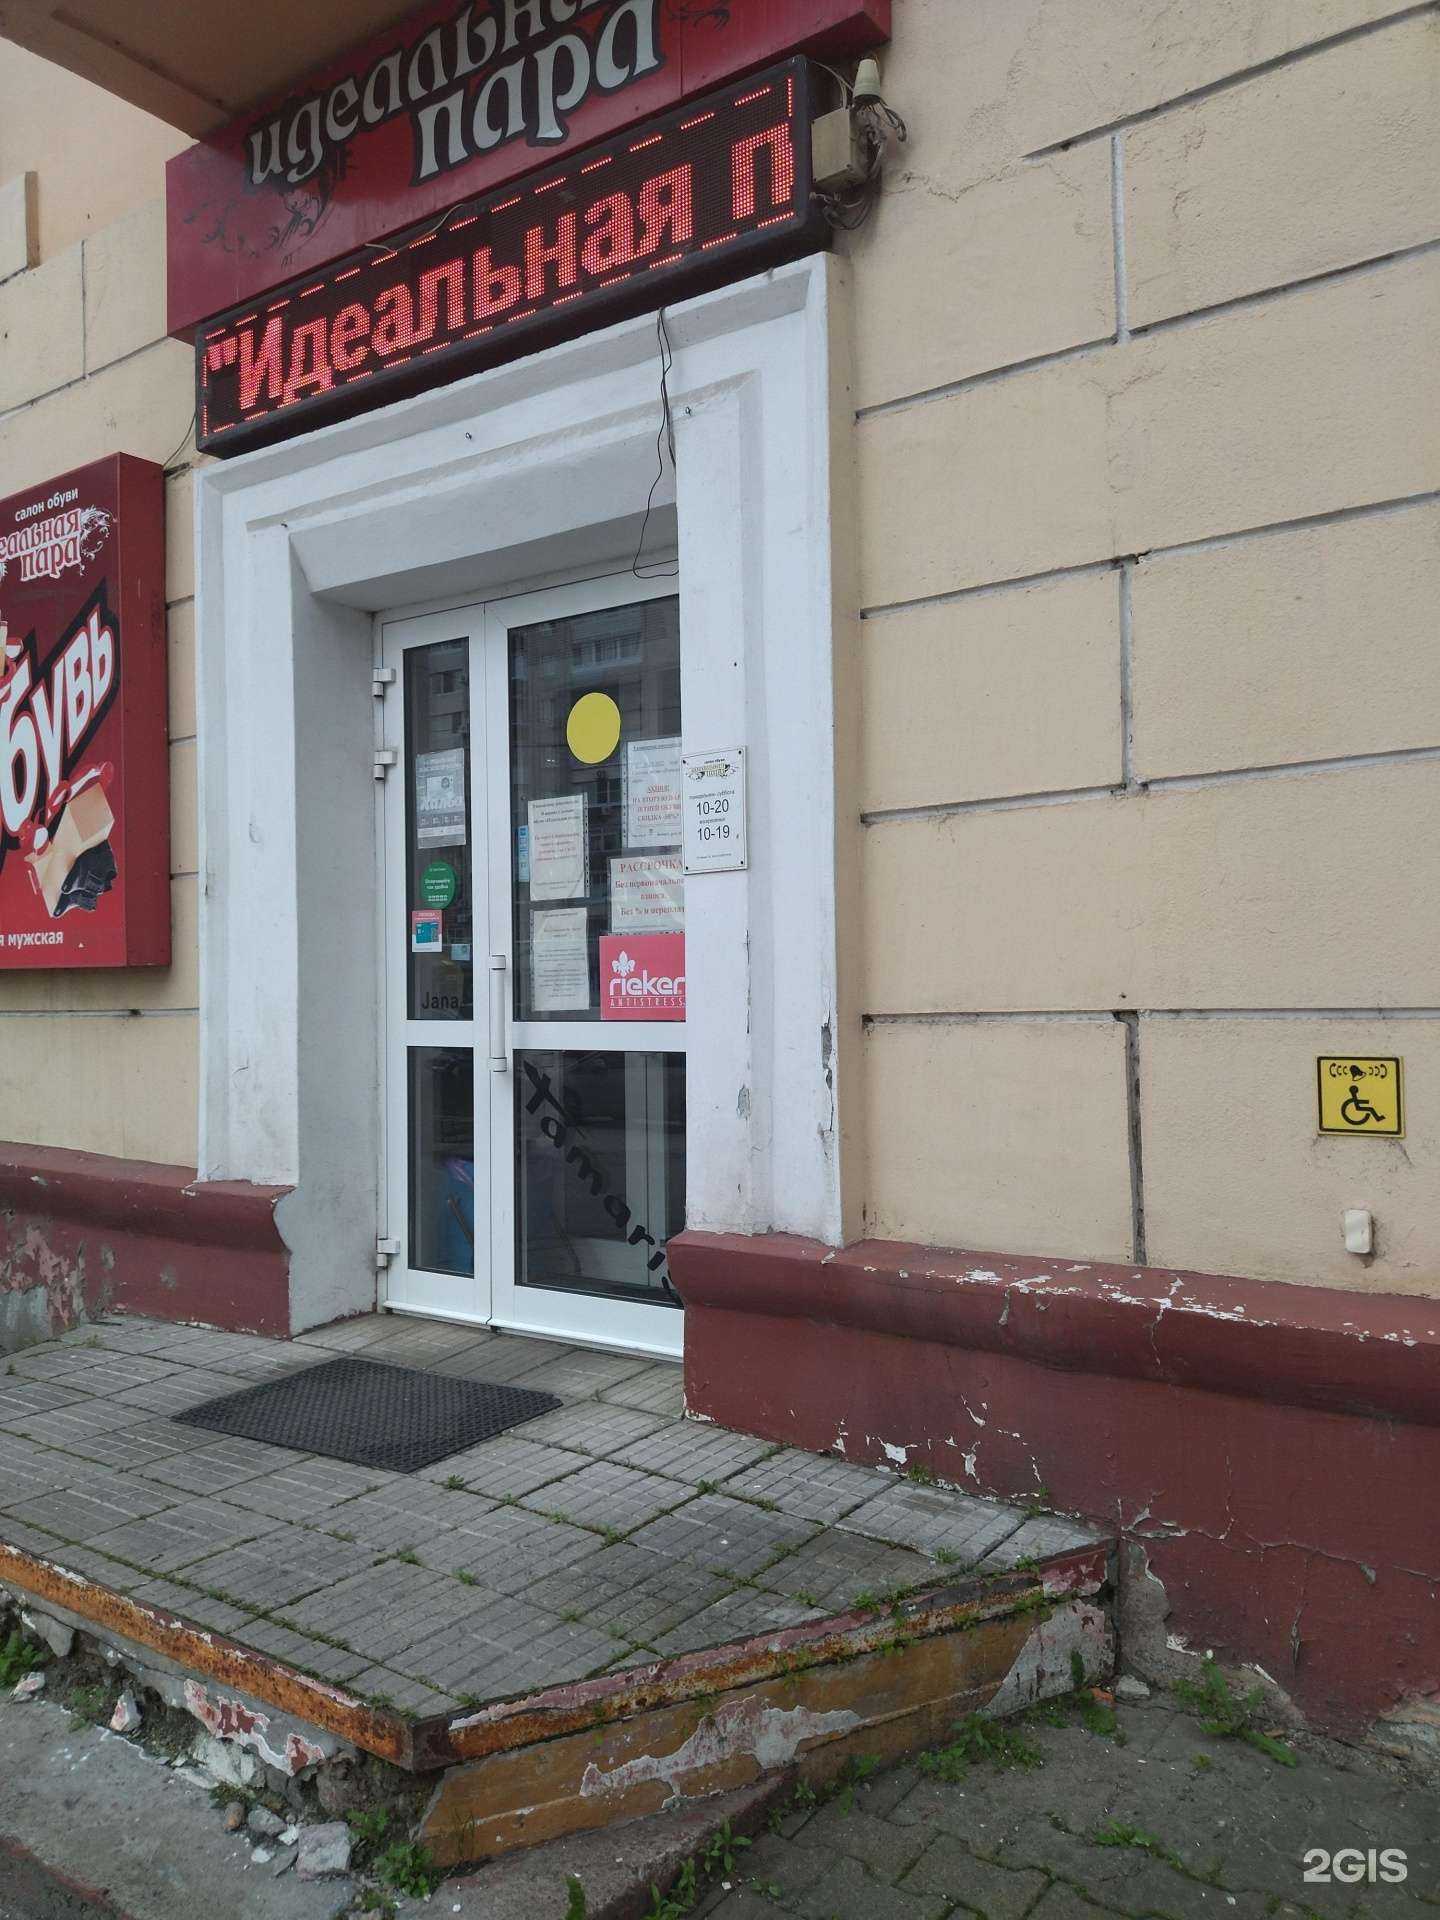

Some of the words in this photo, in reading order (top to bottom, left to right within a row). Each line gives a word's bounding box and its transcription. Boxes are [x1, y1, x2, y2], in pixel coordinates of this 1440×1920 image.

[415, 0, 662, 179] пара
[15, 501, 45, 522] салон
[46, 487, 79, 511] обуви
[0, 508, 82, 561] еальная
[21, 535, 81, 581] пара
[0, 609, 113, 834] бувь
[696, 798, 729, 815] 10-20
[697, 824, 730, 841] 10-19
[651, 905, 685, 916] переплат
[8, 931, 64, 950] мужская
[609, 968, 686, 996] rieker
